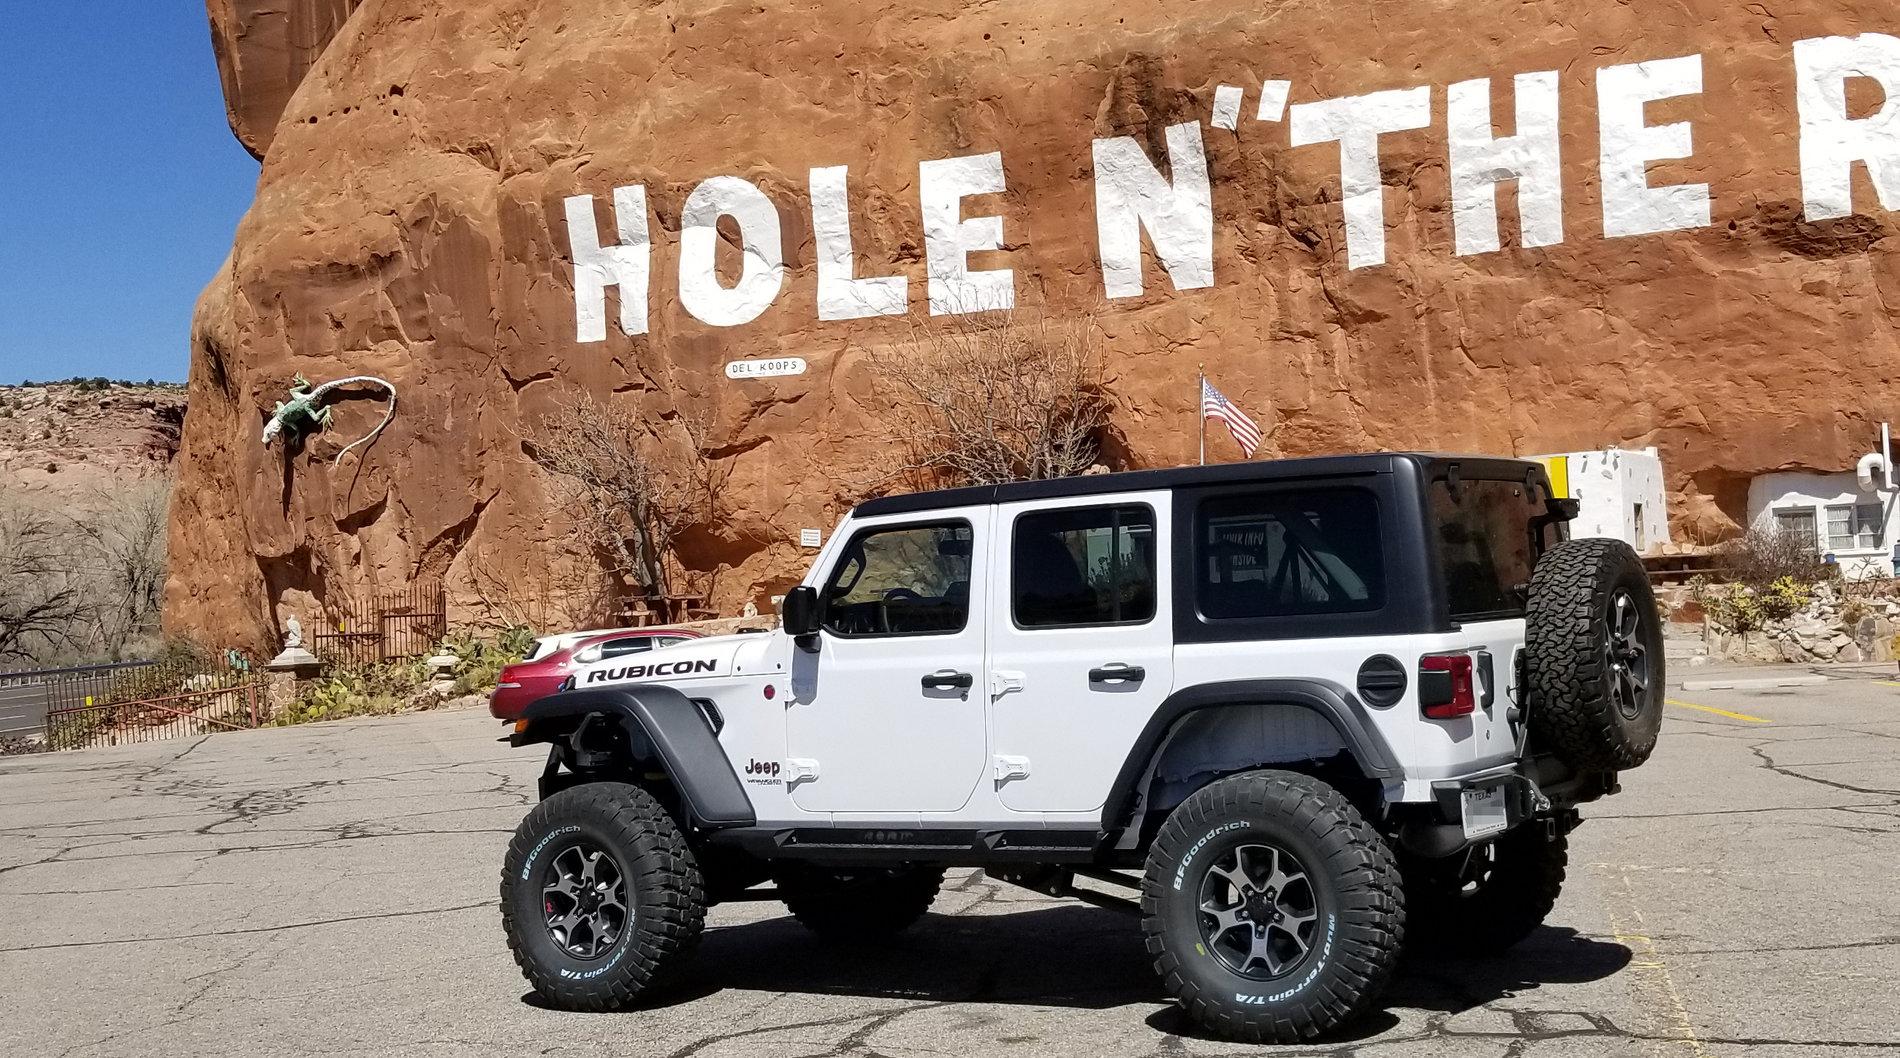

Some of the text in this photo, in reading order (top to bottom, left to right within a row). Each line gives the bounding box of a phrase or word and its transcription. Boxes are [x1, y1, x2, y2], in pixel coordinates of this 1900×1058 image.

[564, 151, 1015, 343] HOLE
[1290, 53, 1711, 270] THE
[732, 361, 798, 373] DEL KOOPS
[587, 659, 717, 683] RUBICON
[745, 758, 780, 777] Jeep
[521, 825, 581, 881] BFGoodrich
[1173, 820, 1251, 891] BFGoodrich
